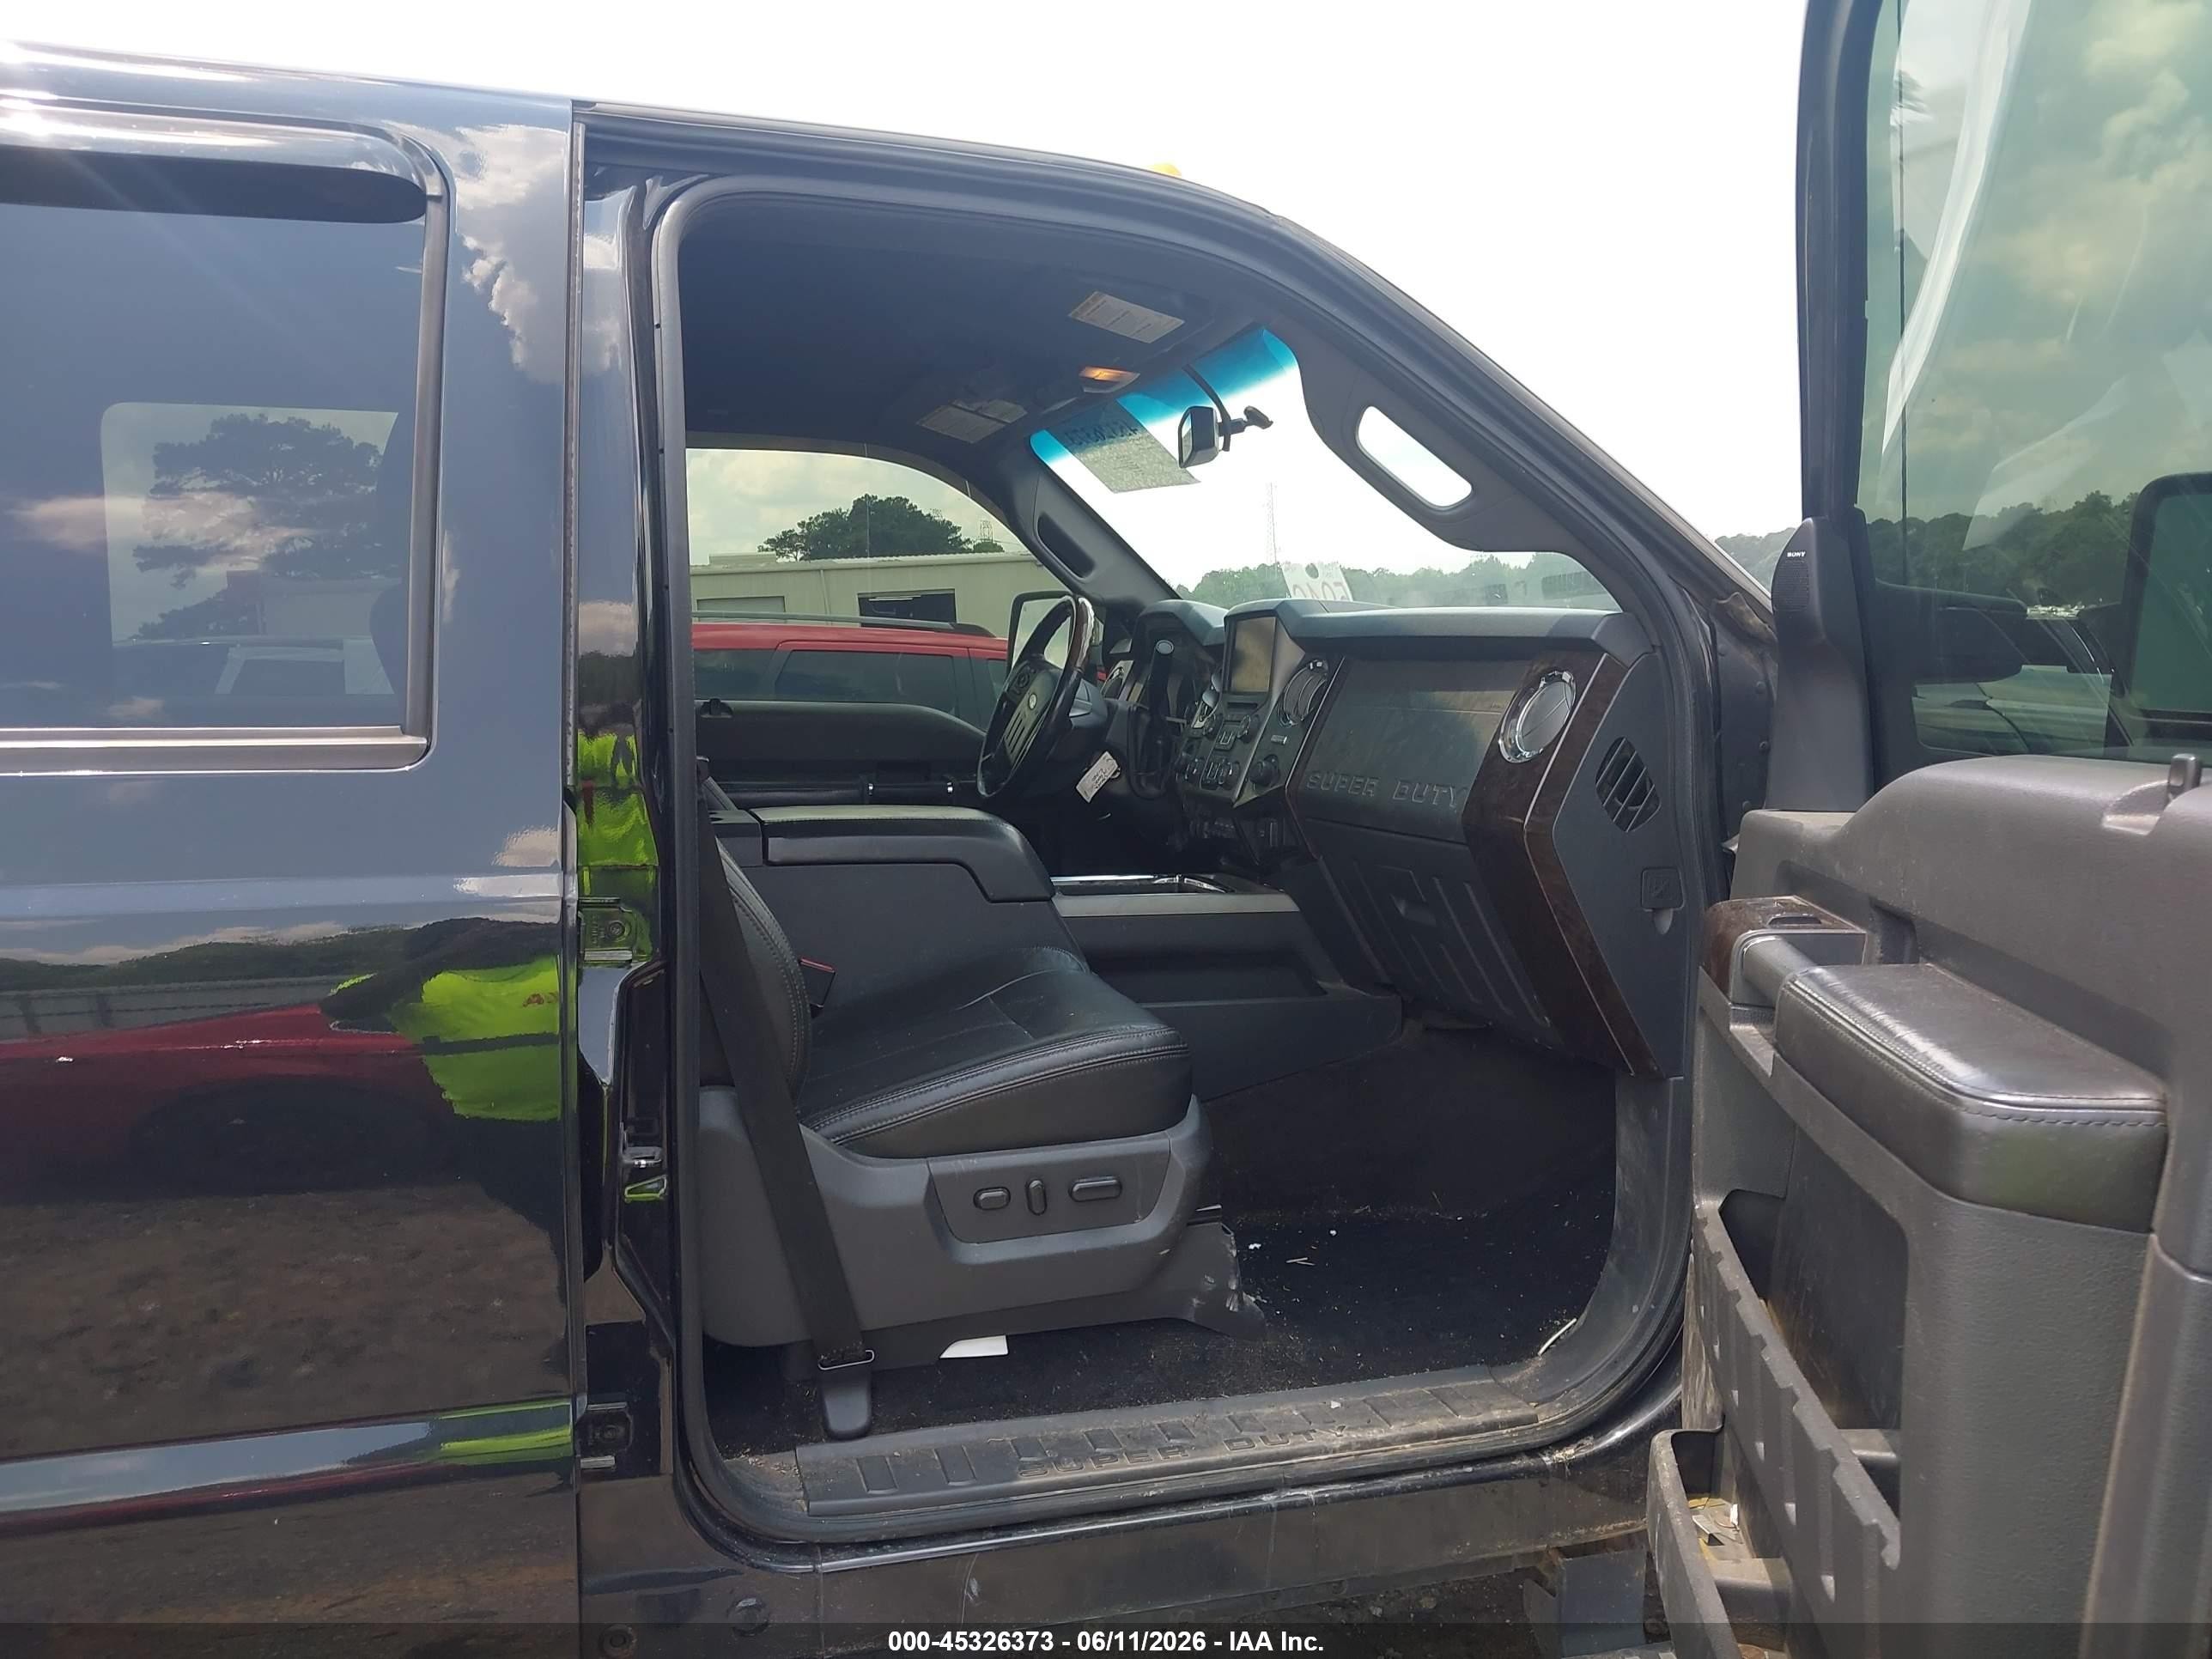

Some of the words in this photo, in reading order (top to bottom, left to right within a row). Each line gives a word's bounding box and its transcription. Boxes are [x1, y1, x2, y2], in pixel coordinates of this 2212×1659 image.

[1306, 773, 1380, 797] SUPER
[1392, 780, 1468, 810] DUTY
[1018, 1445, 1189, 1478] SUPER
[1223, 1425, 1346, 1451] DUTY
